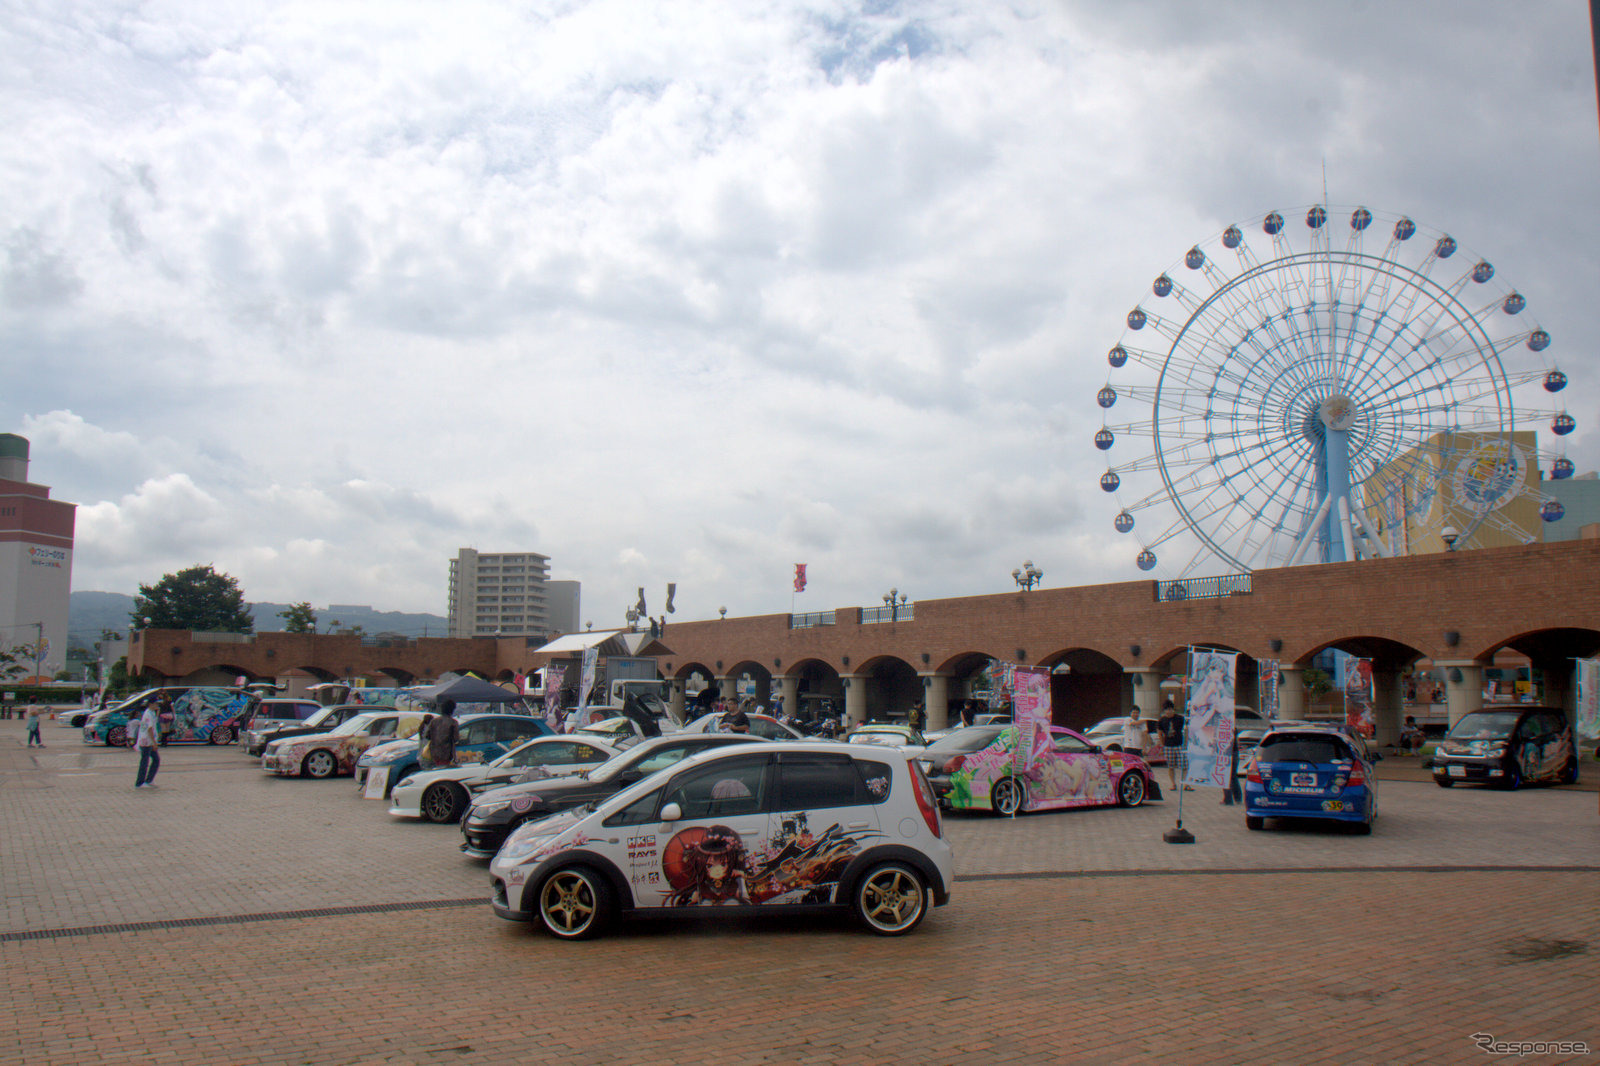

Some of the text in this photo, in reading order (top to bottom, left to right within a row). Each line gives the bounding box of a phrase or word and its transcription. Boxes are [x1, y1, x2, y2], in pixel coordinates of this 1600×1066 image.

[1283, 786, 1325, 794] MICHELIN
[627, 835, 656, 848] HKS
[628, 850, 657, 859] RAYS
